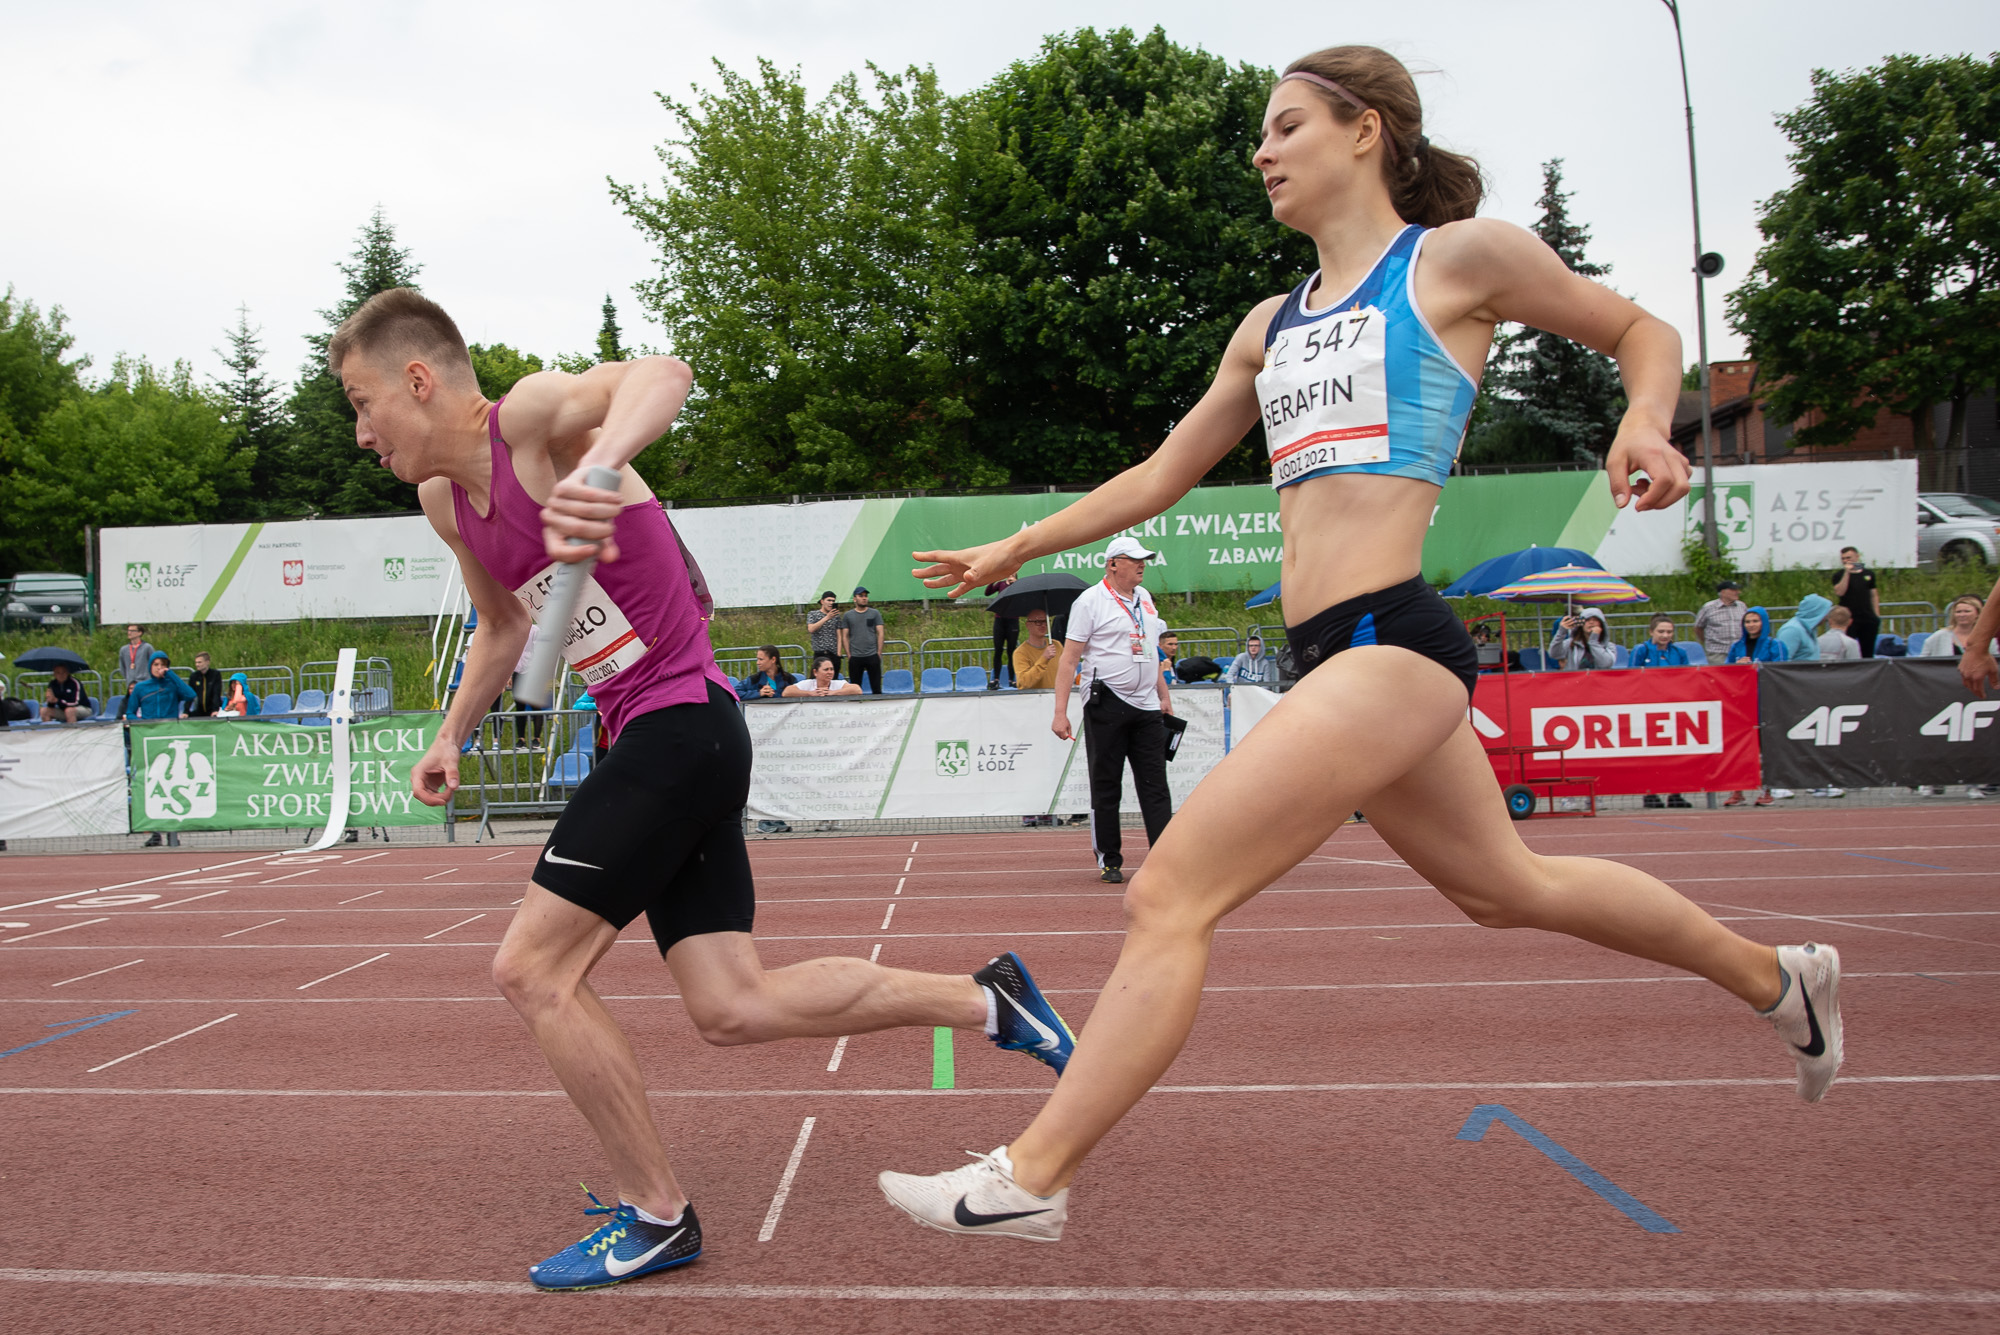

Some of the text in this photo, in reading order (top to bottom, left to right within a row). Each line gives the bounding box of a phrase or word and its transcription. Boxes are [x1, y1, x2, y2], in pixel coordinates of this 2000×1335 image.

[1304, 315, 1370, 363] 547
[1265, 374, 1353, 430] SERAFIN
[1304, 447, 1336, 469] 2021
[1771, 490, 1831, 512] AZS
[1175, 511, 1283, 541] ZWIĄZEK
[1769, 517, 1846, 543] ŁÓDŹ
[1208, 546, 1284, 565] ZABAWA
[157, 565, 180, 575] AZS
[599, 659, 620, 678] 2021
[839, 720, 877, 729] ZABAWA
[1543, 710, 1710, 749] ORLEN
[1788, 701, 2000, 745] 4F 4F
[792, 736, 829, 745] ZABAWA
[838, 736, 868, 745] SPORT
[759, 747, 894, 760] ATMOSFERA ZABAWA SPORT
[977, 744, 1007, 756] AZS
[755, 764, 786, 773] SPORT
[790, 763, 843, 772] ATMOSFERA
[848, 761, 886, 771] ZABAWA
[977, 758, 1015, 772] ŁÓDŹ
[781, 775, 811, 785] SPORT
[817, 775, 870, 784] ATMOSFERA
[769, 790, 822, 800] ATMOSFERA
[826, 789, 863, 799] ZABAWA
[796, 803, 850, 813] ATMOSFERA
